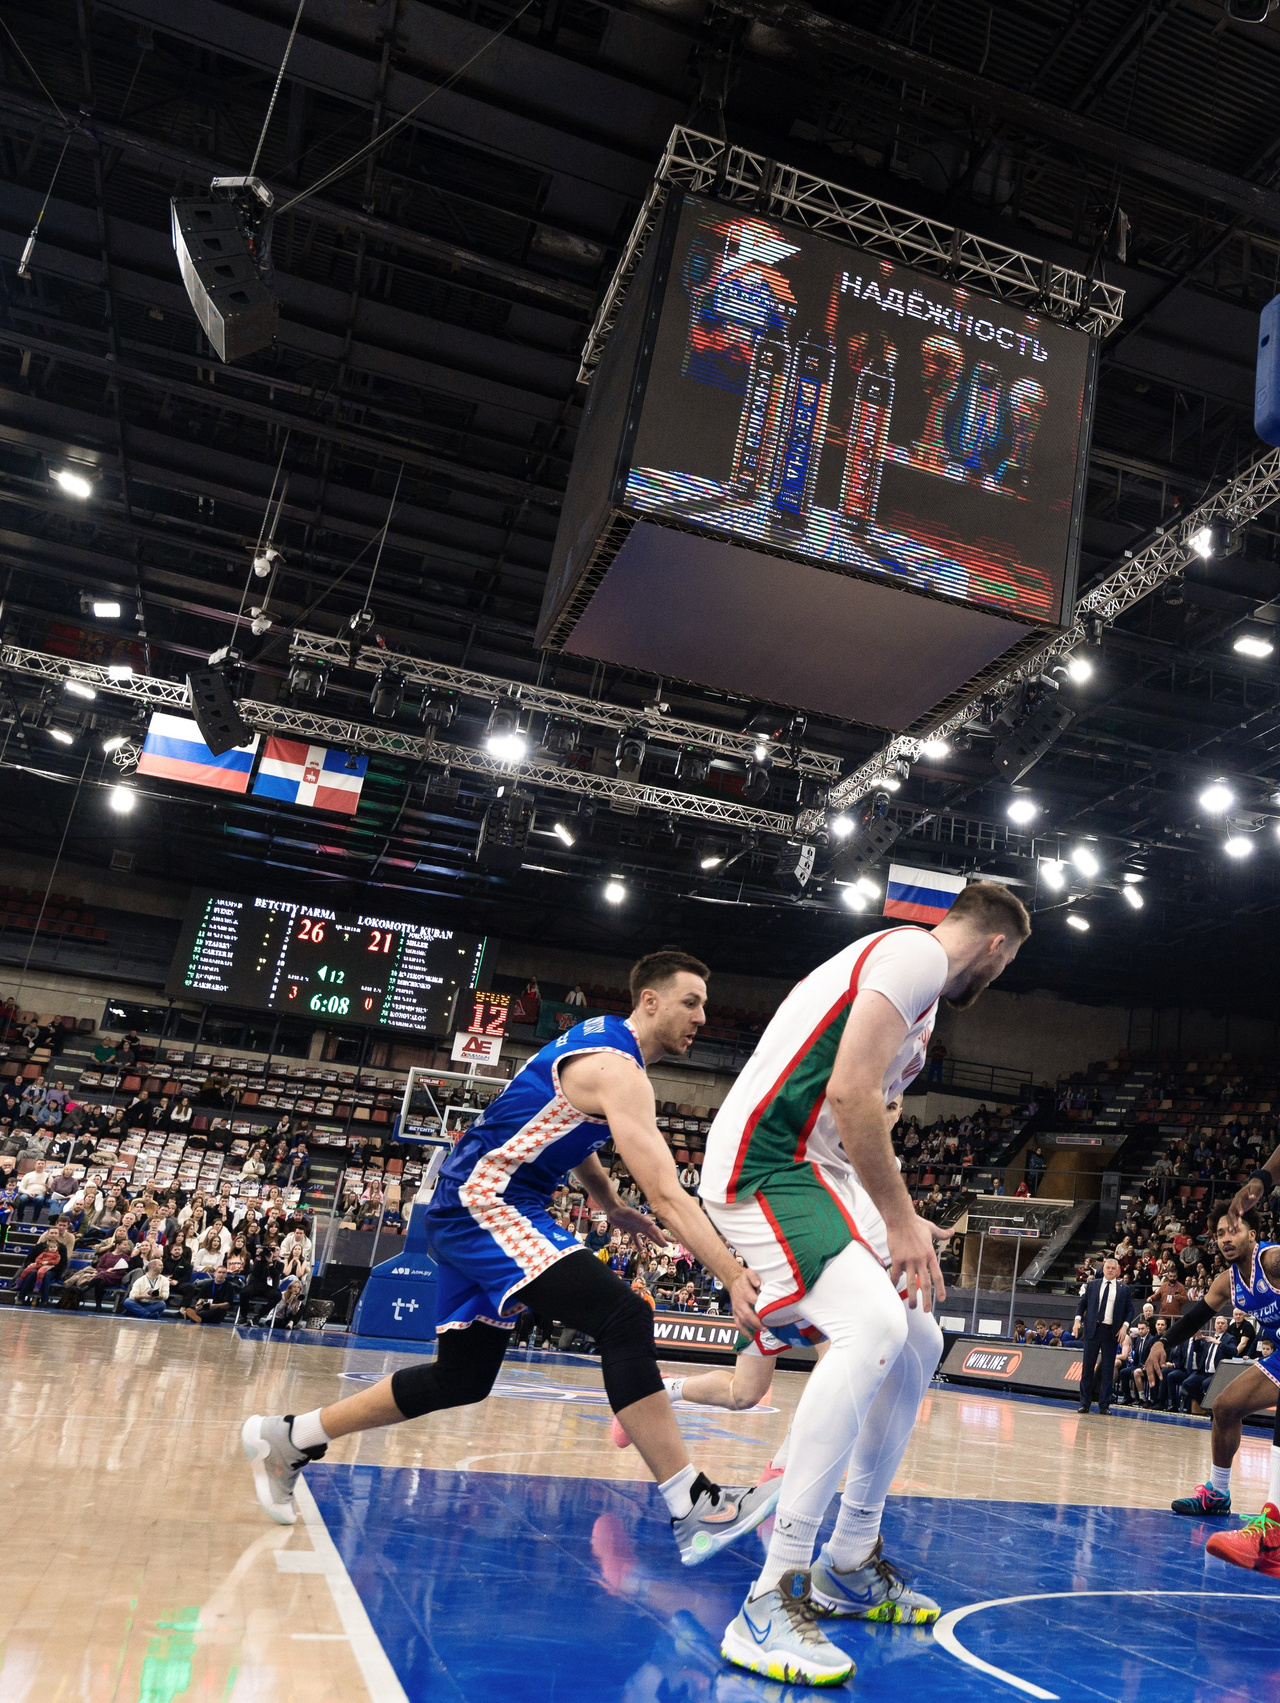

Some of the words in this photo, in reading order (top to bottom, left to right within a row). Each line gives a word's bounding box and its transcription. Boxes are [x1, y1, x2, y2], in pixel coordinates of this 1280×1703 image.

[840, 271, 1048, 362] НАДЁЖНОСТЬ
[254, 898, 299, 913] BETCITY
[300, 906, 336, 920] PARMA
[297, 918, 326, 943] 26
[357, 915, 418, 933] LOKOMOTIV
[420, 926, 453, 940] KUBAN
[367, 930, 392, 954] 21
[330, 970, 345, 984] 12
[288, 985, 298, 999] 3
[309, 993, 350, 1015] 6:08
[468, 1004, 508, 1036] 12
[966, 1352, 1009, 1371] WINLINE
